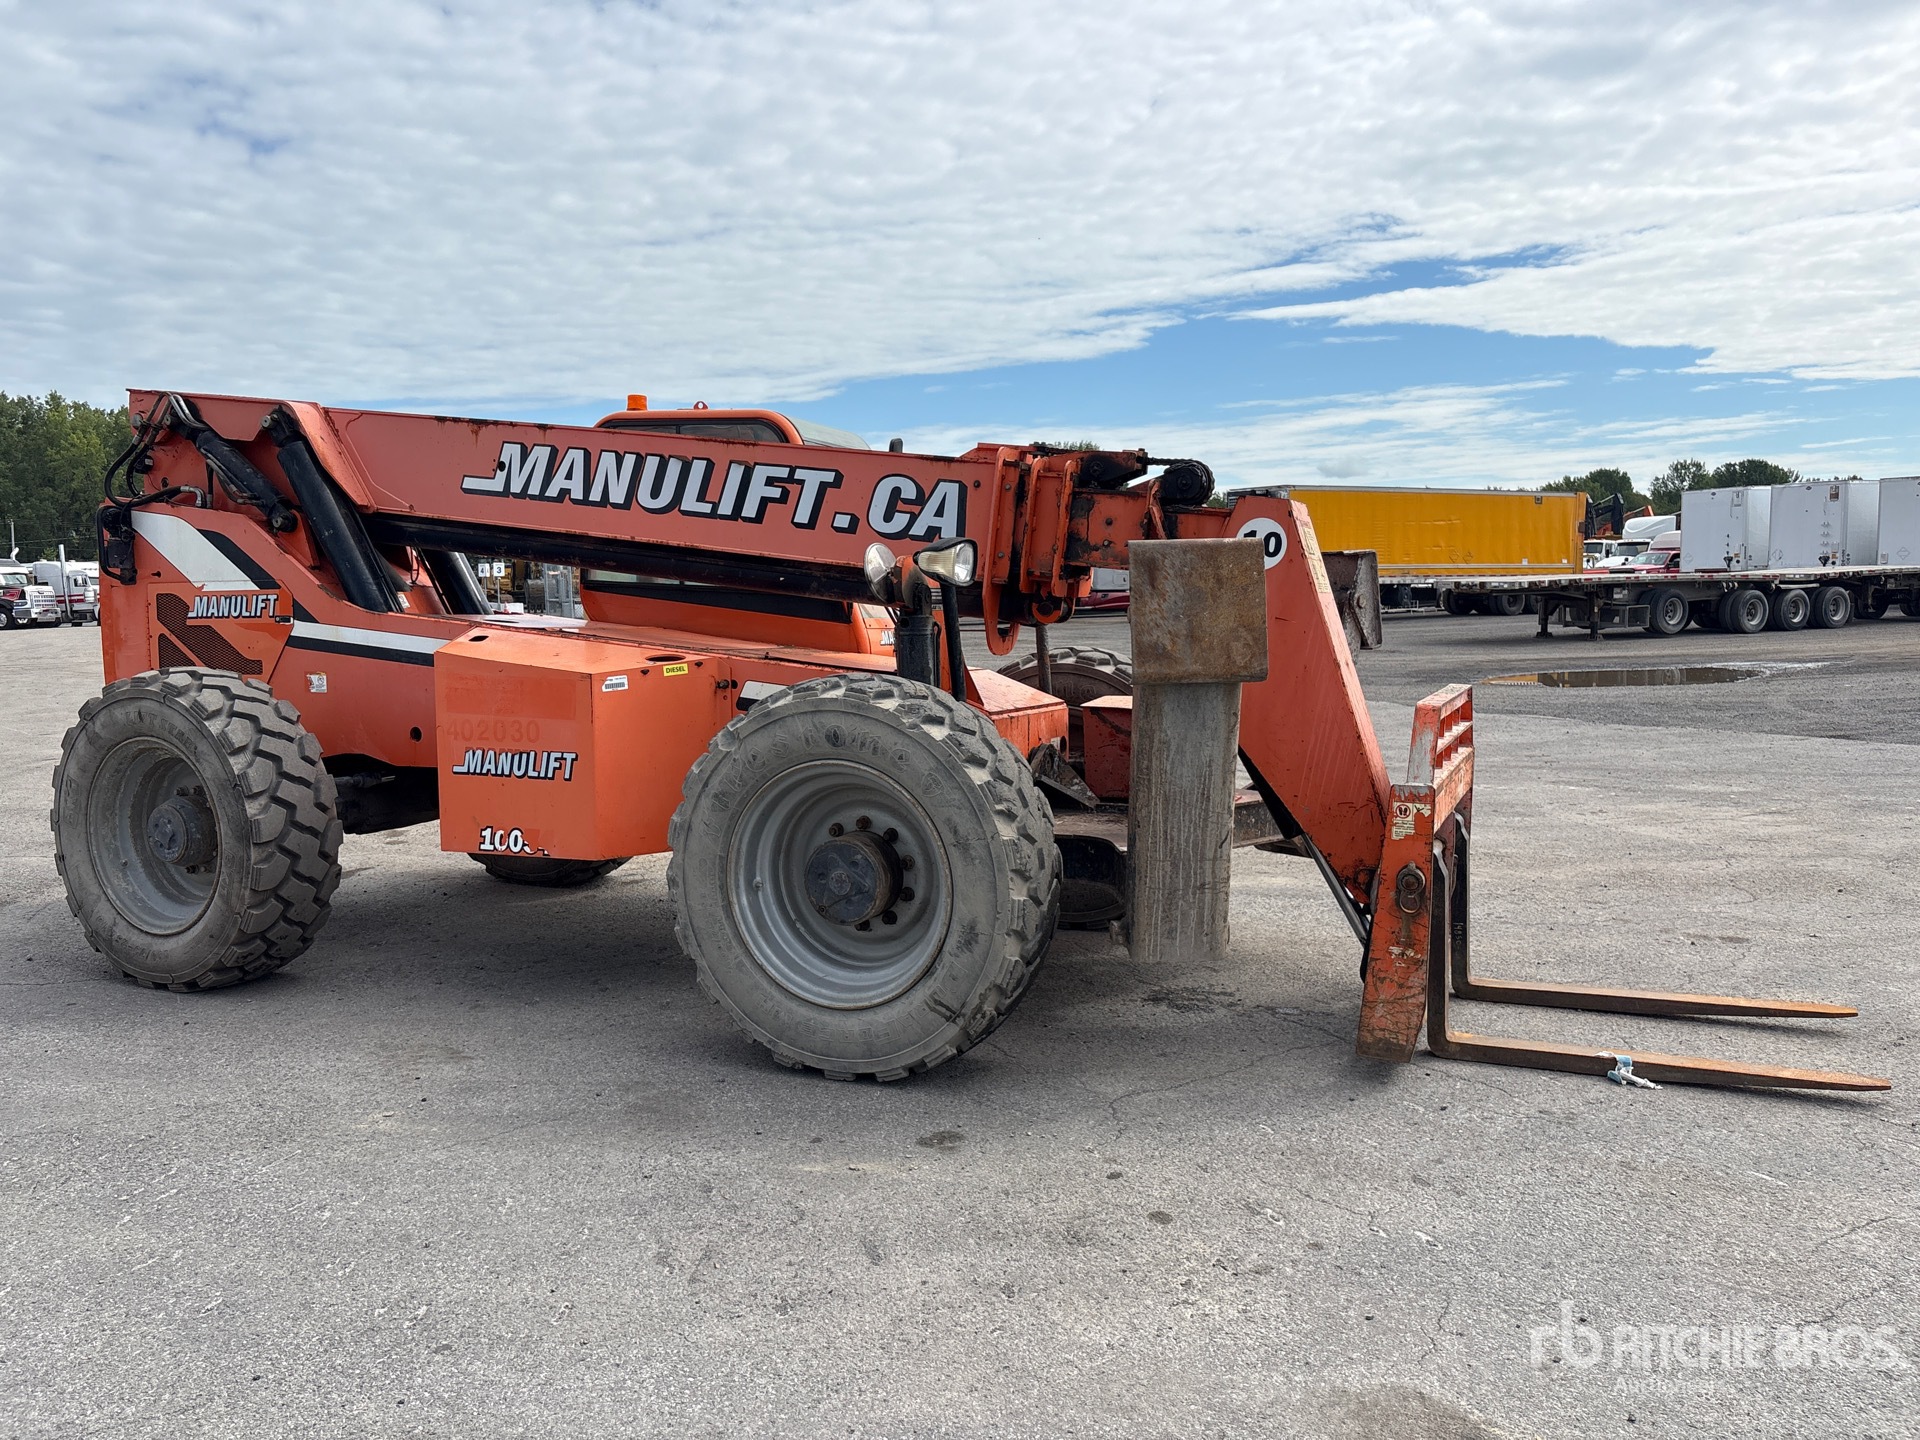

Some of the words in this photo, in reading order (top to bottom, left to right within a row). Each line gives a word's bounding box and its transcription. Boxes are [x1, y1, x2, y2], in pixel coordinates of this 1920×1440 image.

[1243, 530, 1283, 558] 0
[187, 594, 278, 618] MANULIFT
[448, 719, 541, 744] 402030
[452, 748, 579, 782] MANULIFT
